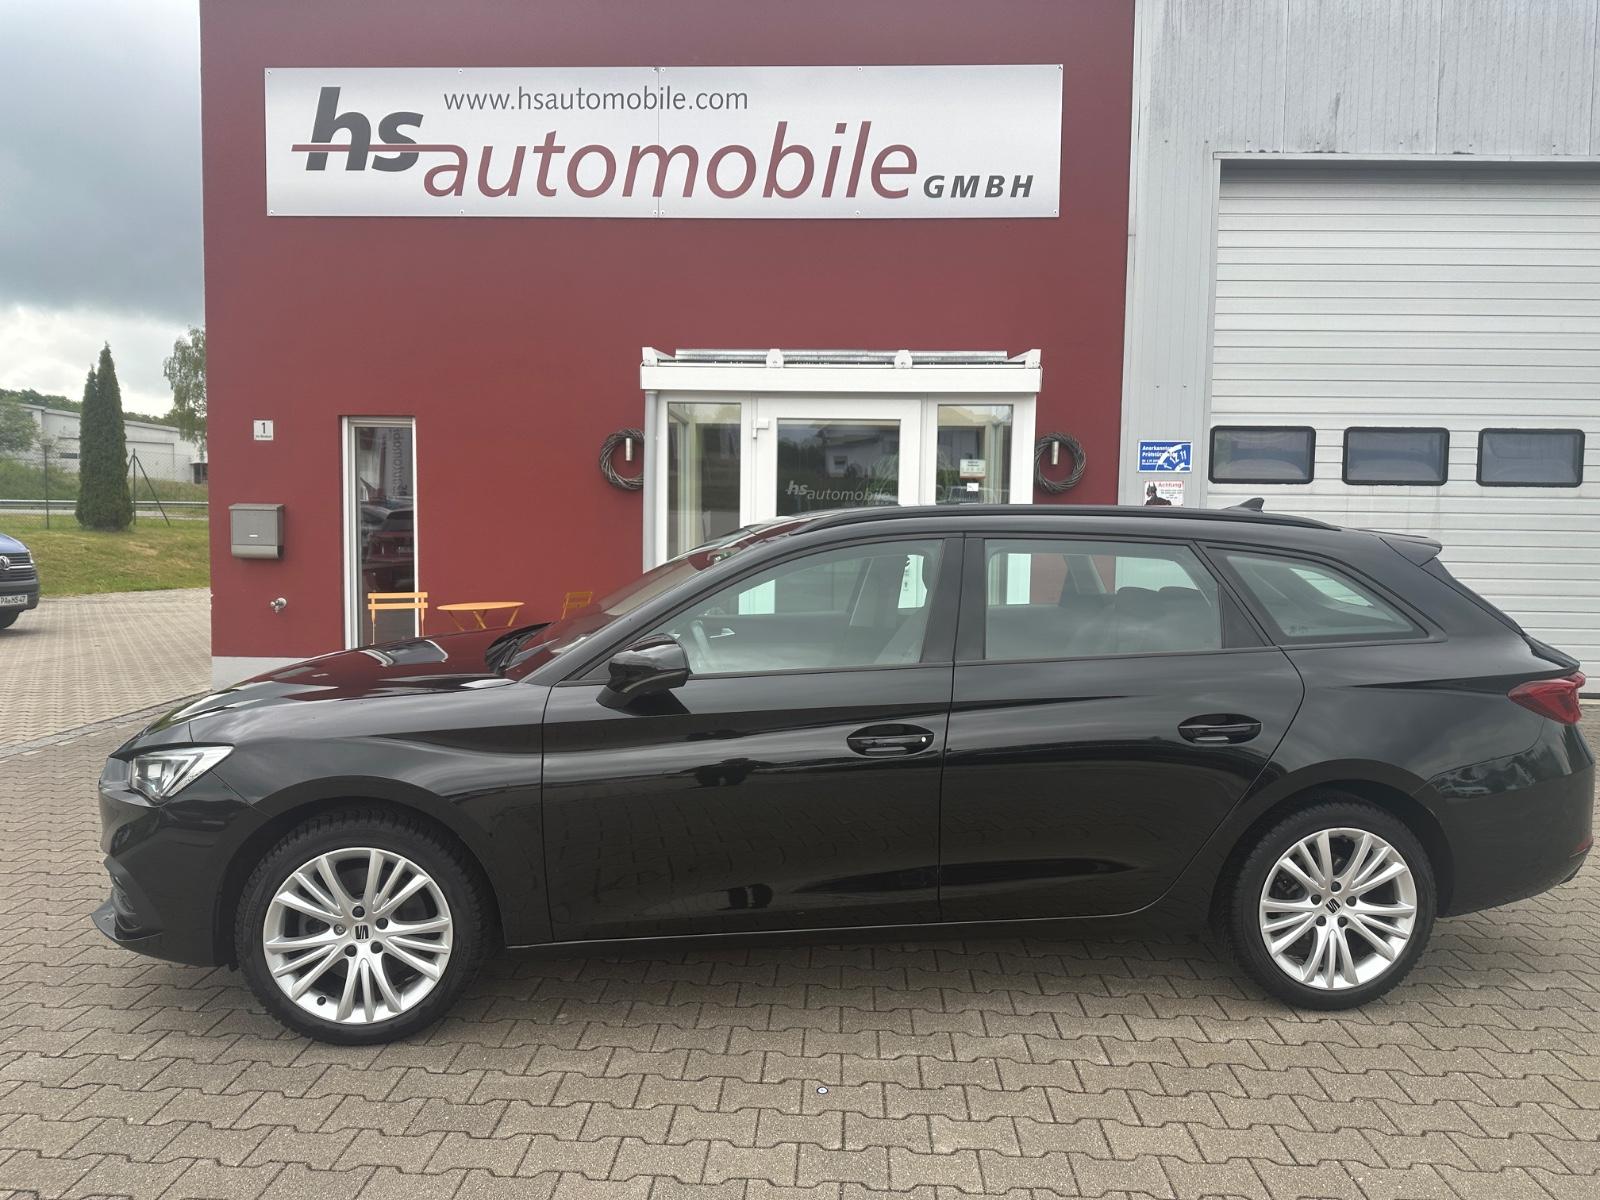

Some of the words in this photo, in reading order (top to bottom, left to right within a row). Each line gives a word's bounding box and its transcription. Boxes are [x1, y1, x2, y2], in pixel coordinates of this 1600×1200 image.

[444, 86, 748, 110] www.hsautomobile.com
[305, 86, 424, 172] hs
[423, 120, 918, 199] automobile
[923, 174, 1034, 198] GMBH
[261, 422, 266, 434] 1
[786, 480, 809, 496] hs
[808, 487, 891, 501] automobile
